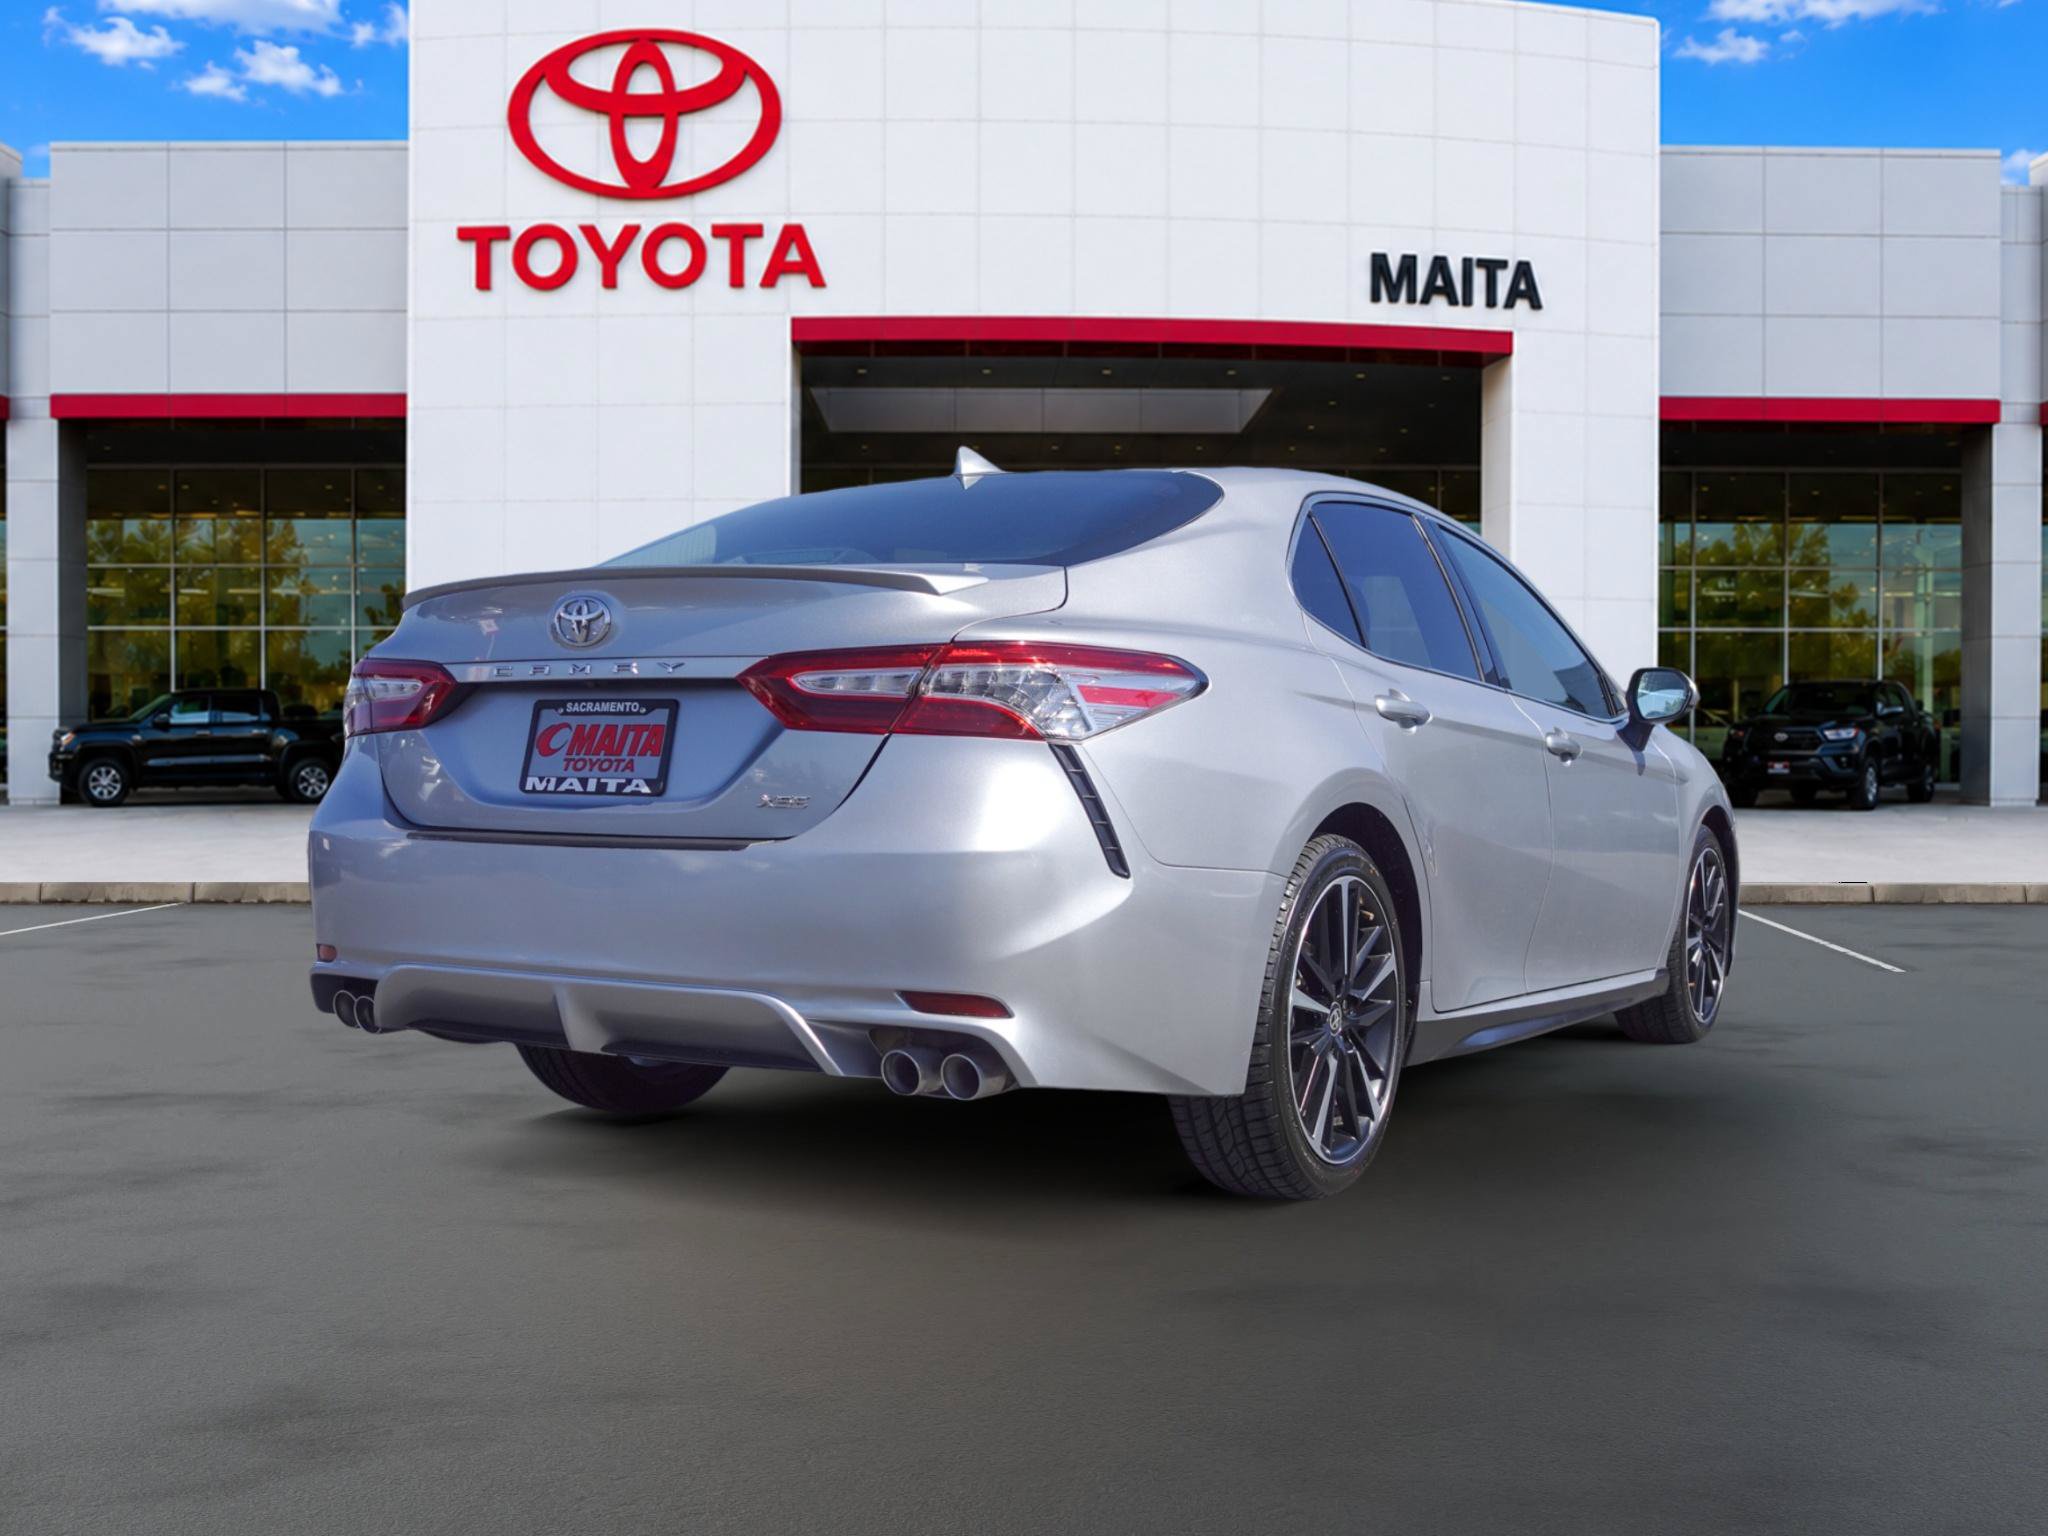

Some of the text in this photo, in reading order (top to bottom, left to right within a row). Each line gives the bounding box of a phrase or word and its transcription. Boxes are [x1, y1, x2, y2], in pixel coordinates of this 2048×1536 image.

[456, 222, 826, 292] TOYOTA
[1370, 252, 1543, 311] MAITA
[566, 702, 639, 713] SACRAMENTO
[563, 758, 635, 772] TOYOTA
[525, 777, 651, 793] MAITA
